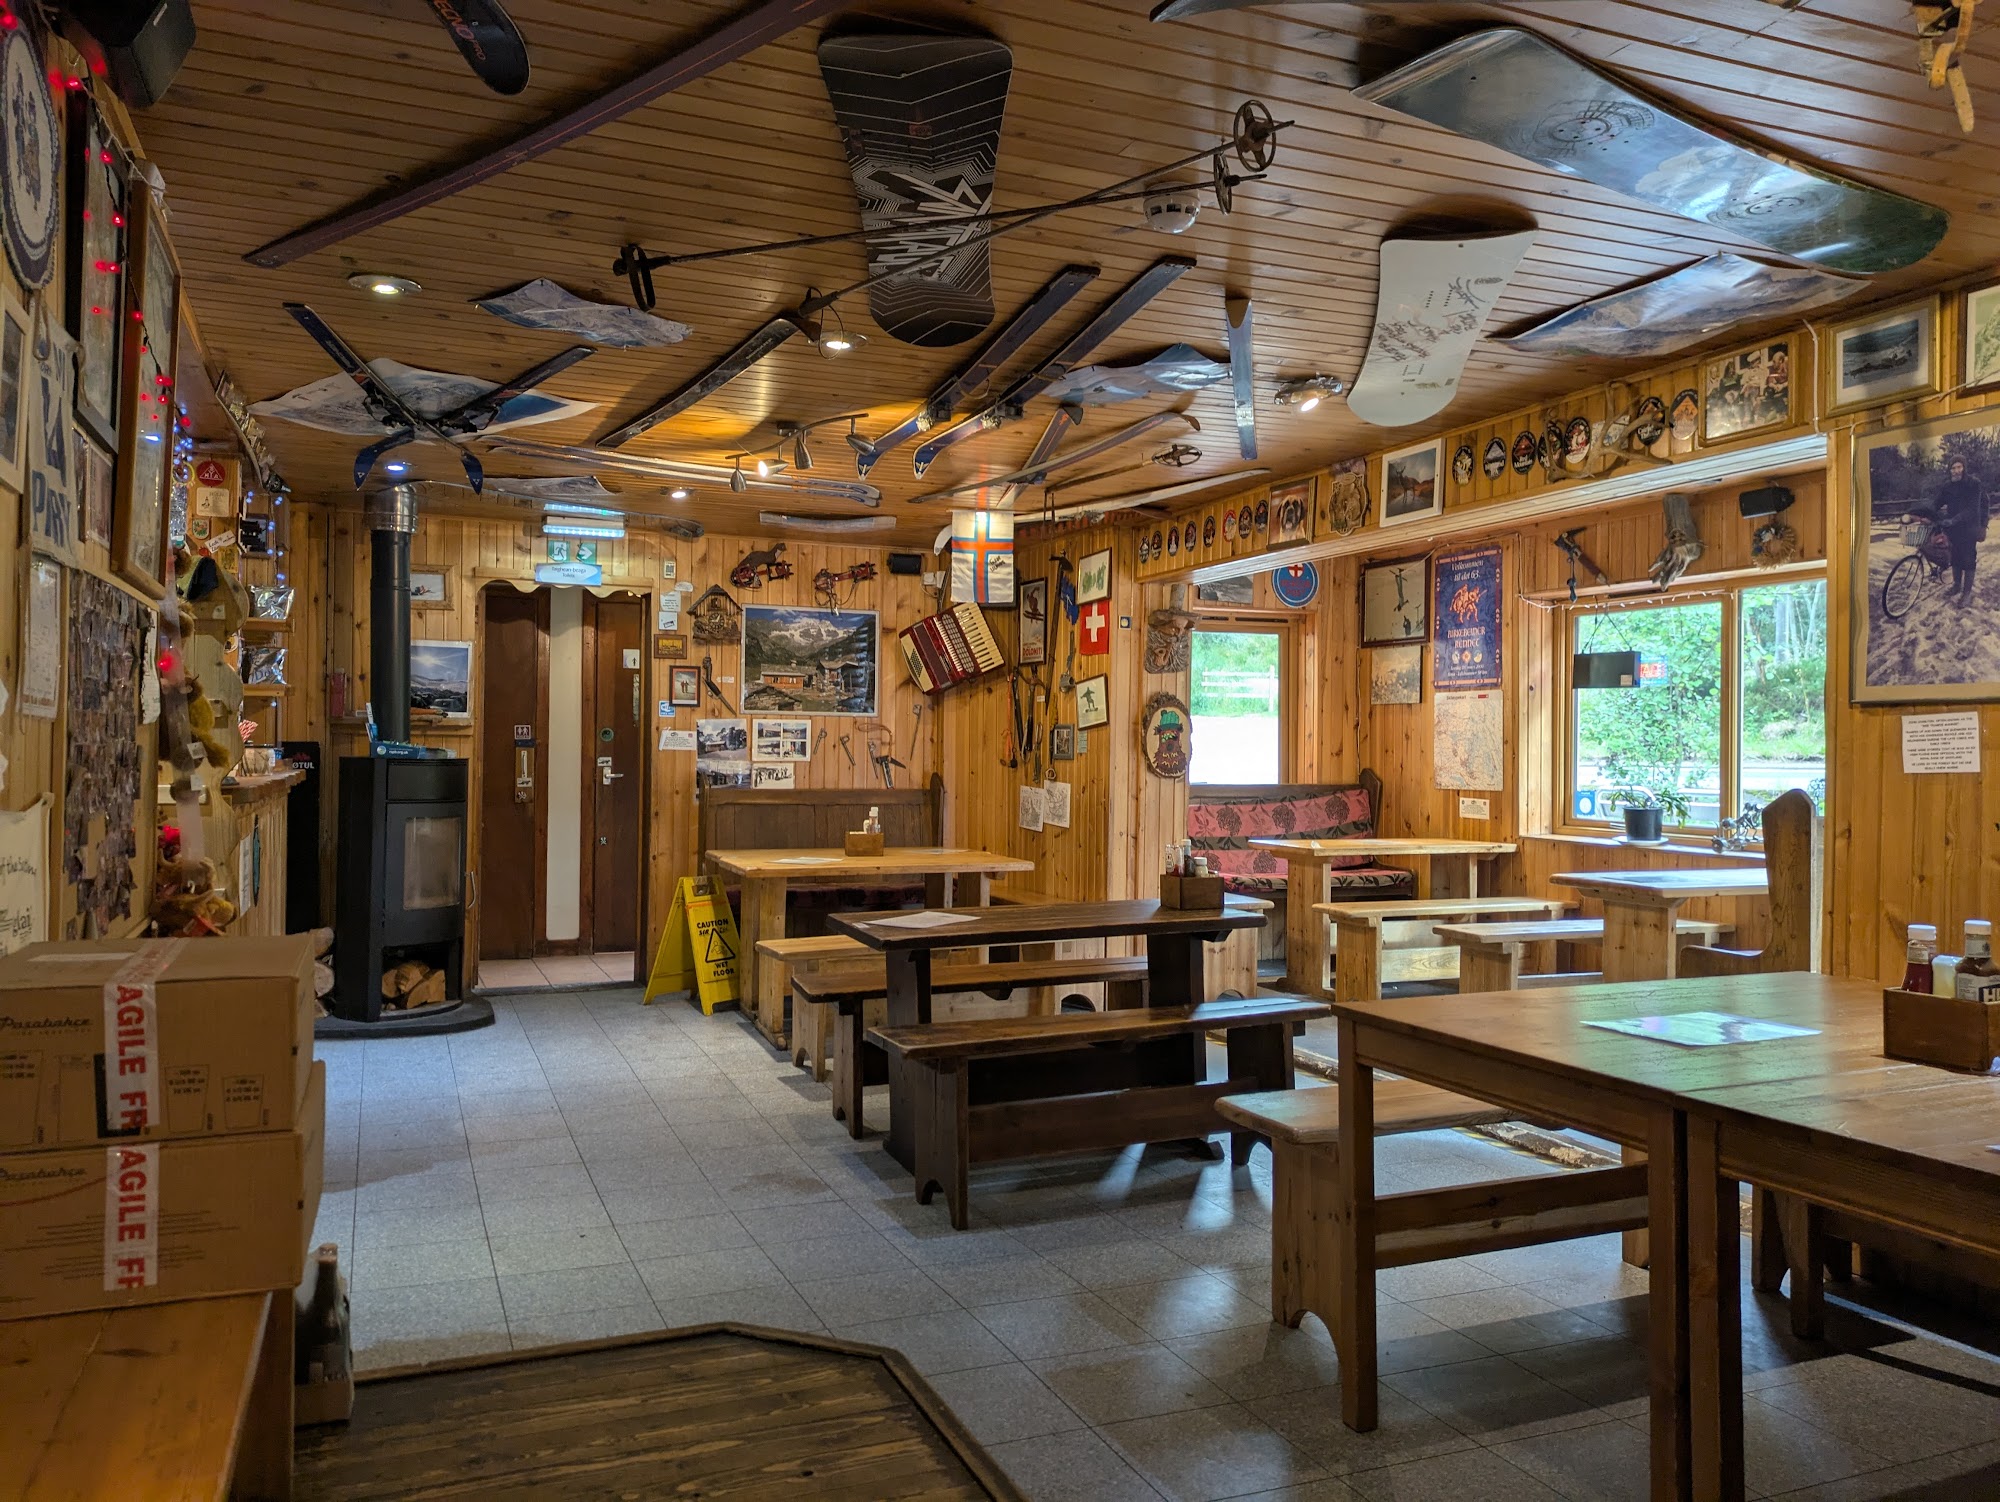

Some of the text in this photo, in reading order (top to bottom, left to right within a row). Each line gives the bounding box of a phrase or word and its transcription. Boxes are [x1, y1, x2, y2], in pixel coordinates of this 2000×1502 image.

[1451, 559, 1484, 572] Velkommen
[1461, 572, 1470, 582] det
[1022, 647, 1043, 657] DOLOMITI
[696, 918, 729, 929] CAUTION
[714, 961, 729, 969] WET
[713, 968, 735, 977] FLOOR
